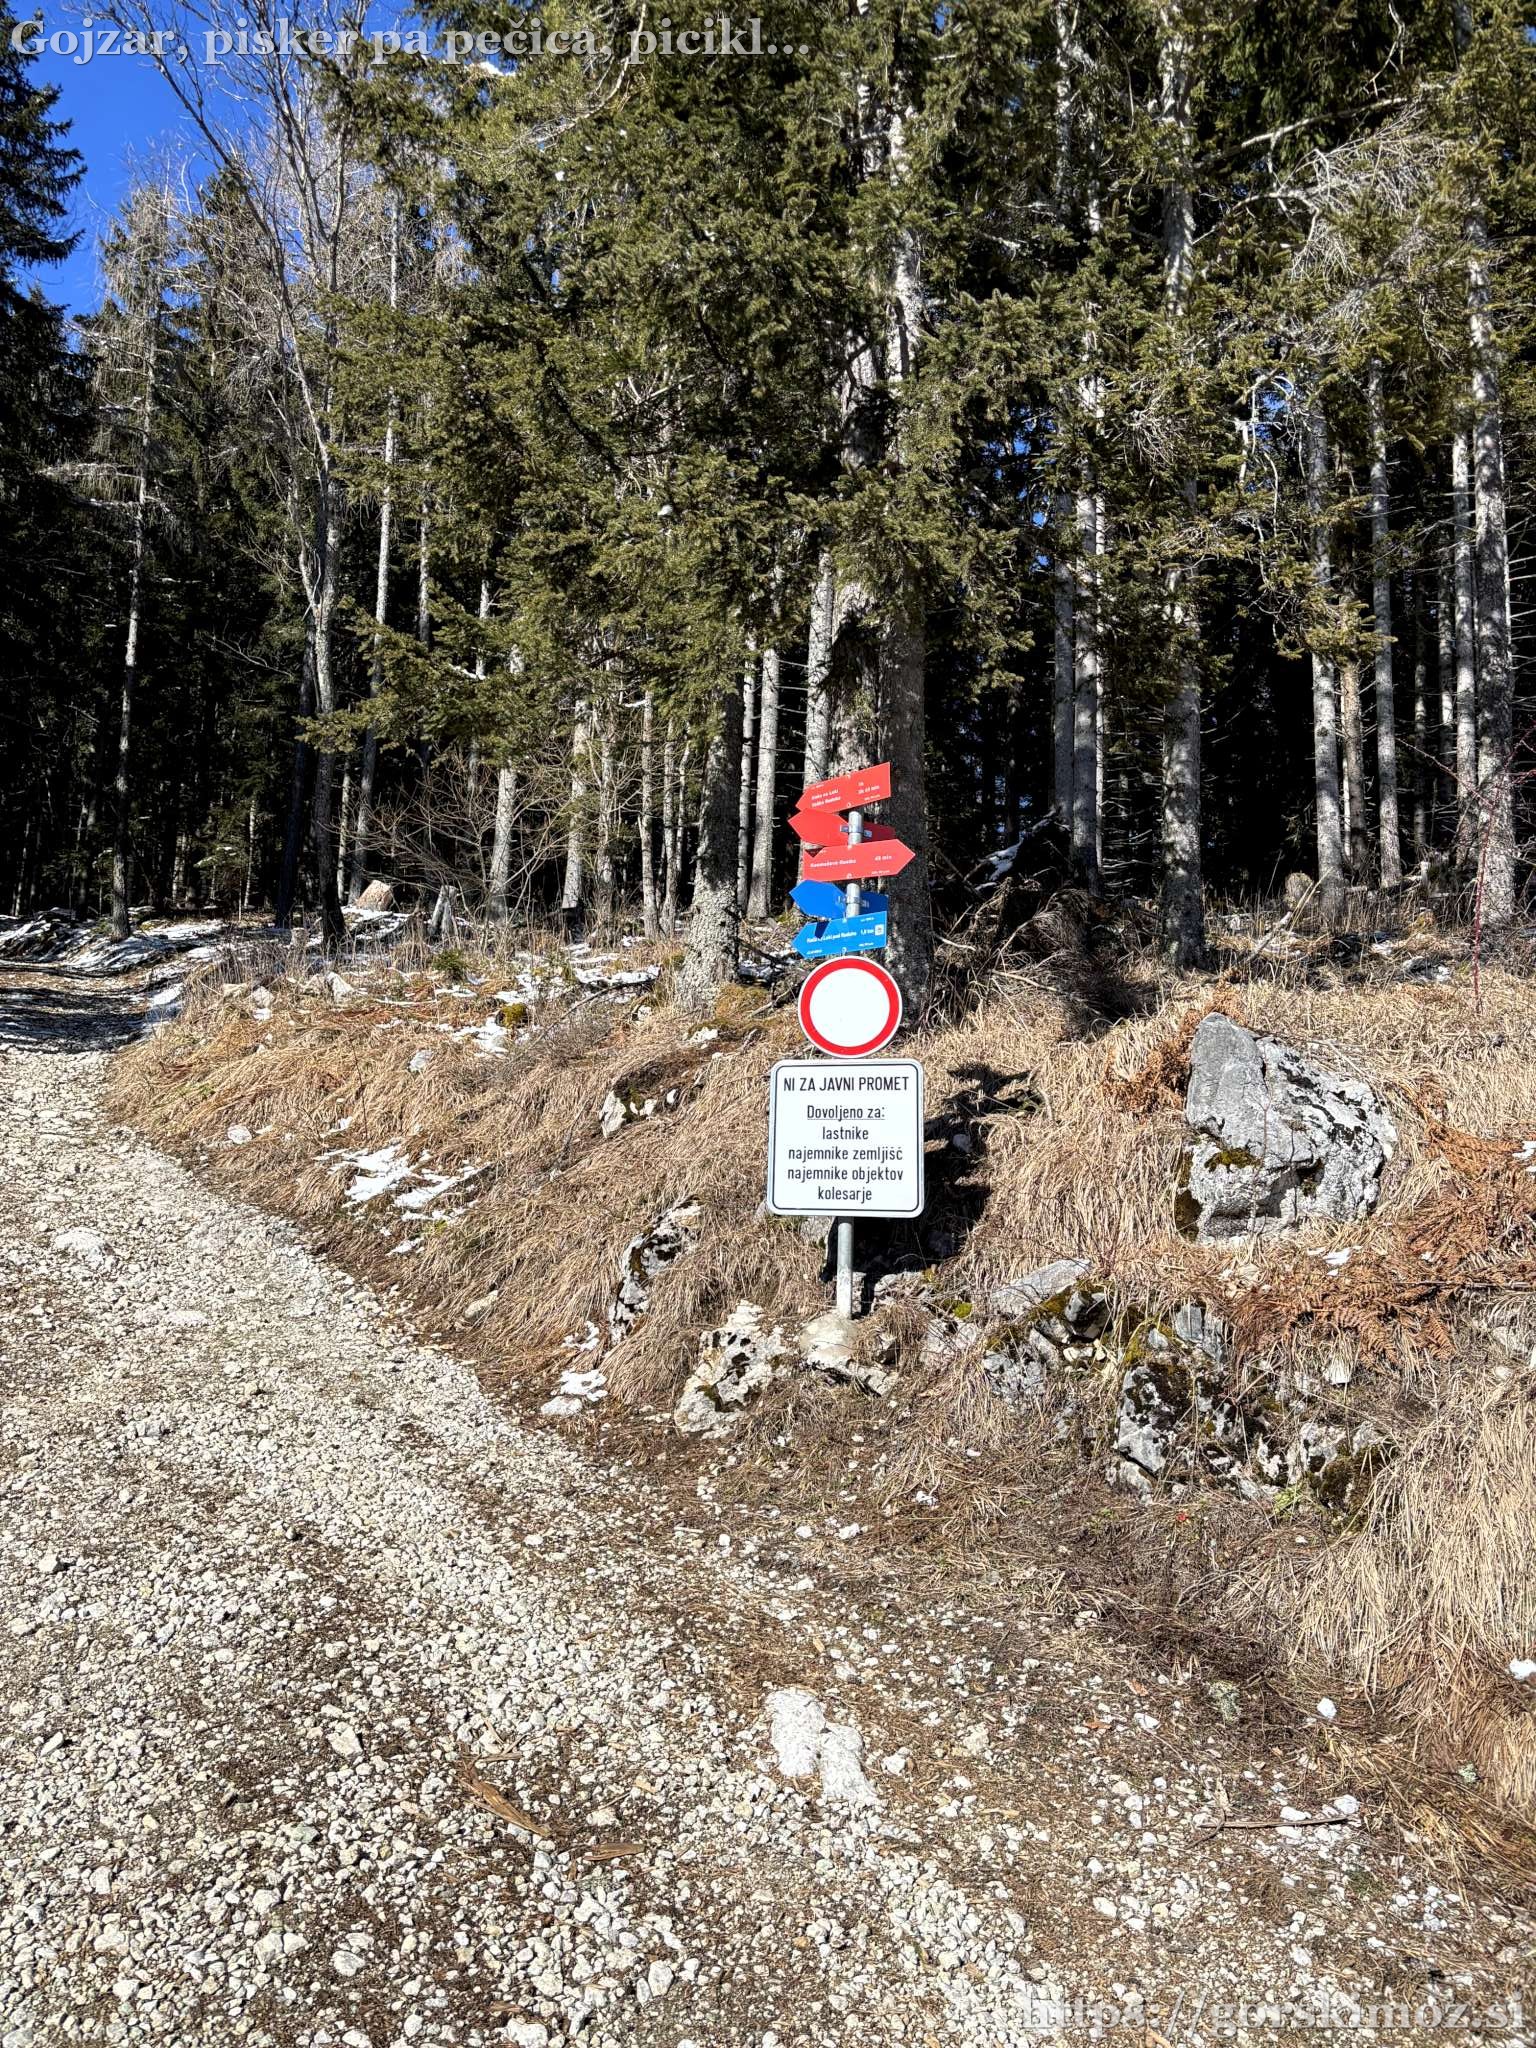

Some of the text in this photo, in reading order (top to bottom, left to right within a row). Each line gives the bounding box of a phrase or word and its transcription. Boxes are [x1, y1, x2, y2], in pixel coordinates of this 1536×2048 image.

[784, 1076, 909, 1091] NI ZA JAVNI PROMET
[807, 1105, 886, 1121] Dovoljeno za:
[822, 1126, 869, 1140] lastnike
[788, 1146, 849, 1163] najemnike
[787, 1166, 904, 1183] najemnike objektov
[817, 1186, 872, 1204] kolesarje
